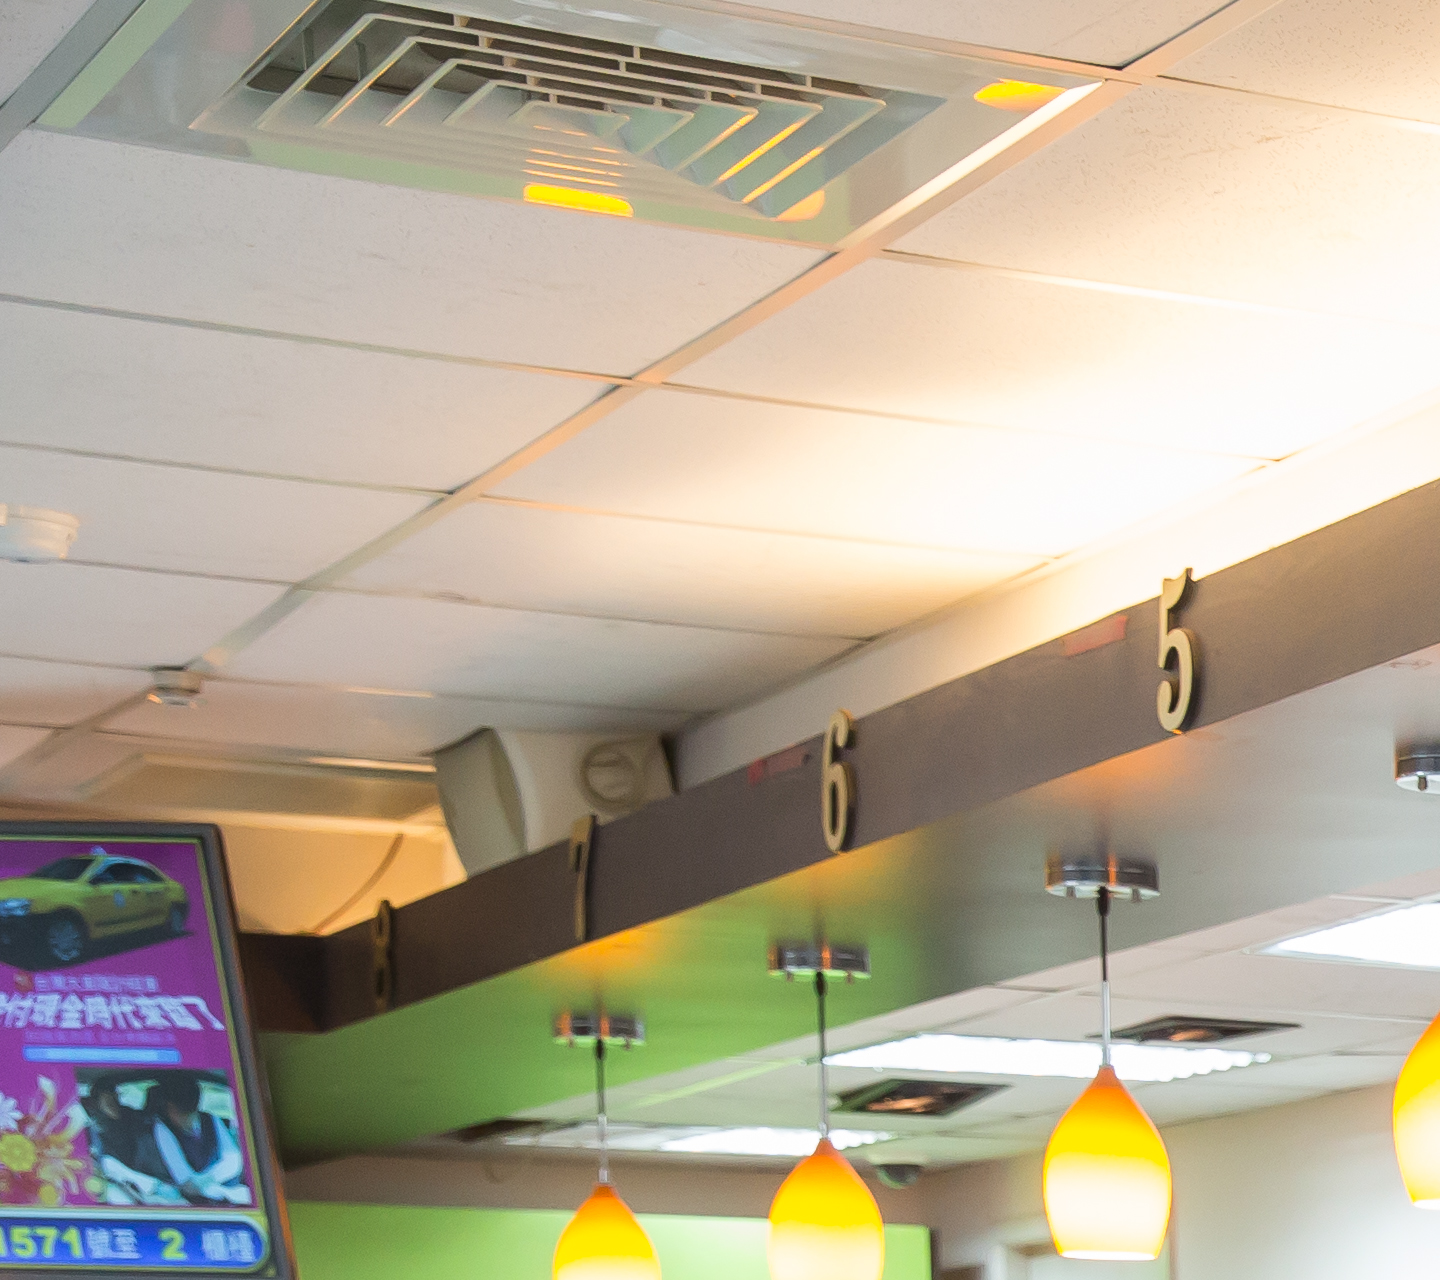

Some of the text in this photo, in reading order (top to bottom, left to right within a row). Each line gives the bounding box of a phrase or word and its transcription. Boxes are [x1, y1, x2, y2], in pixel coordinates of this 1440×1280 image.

[1156, 566, 1197, 735] 5
[821, 708, 857, 853] 6
[0, 1226, 83, 1259] 571
[158, 1229, 188, 1260] 2
